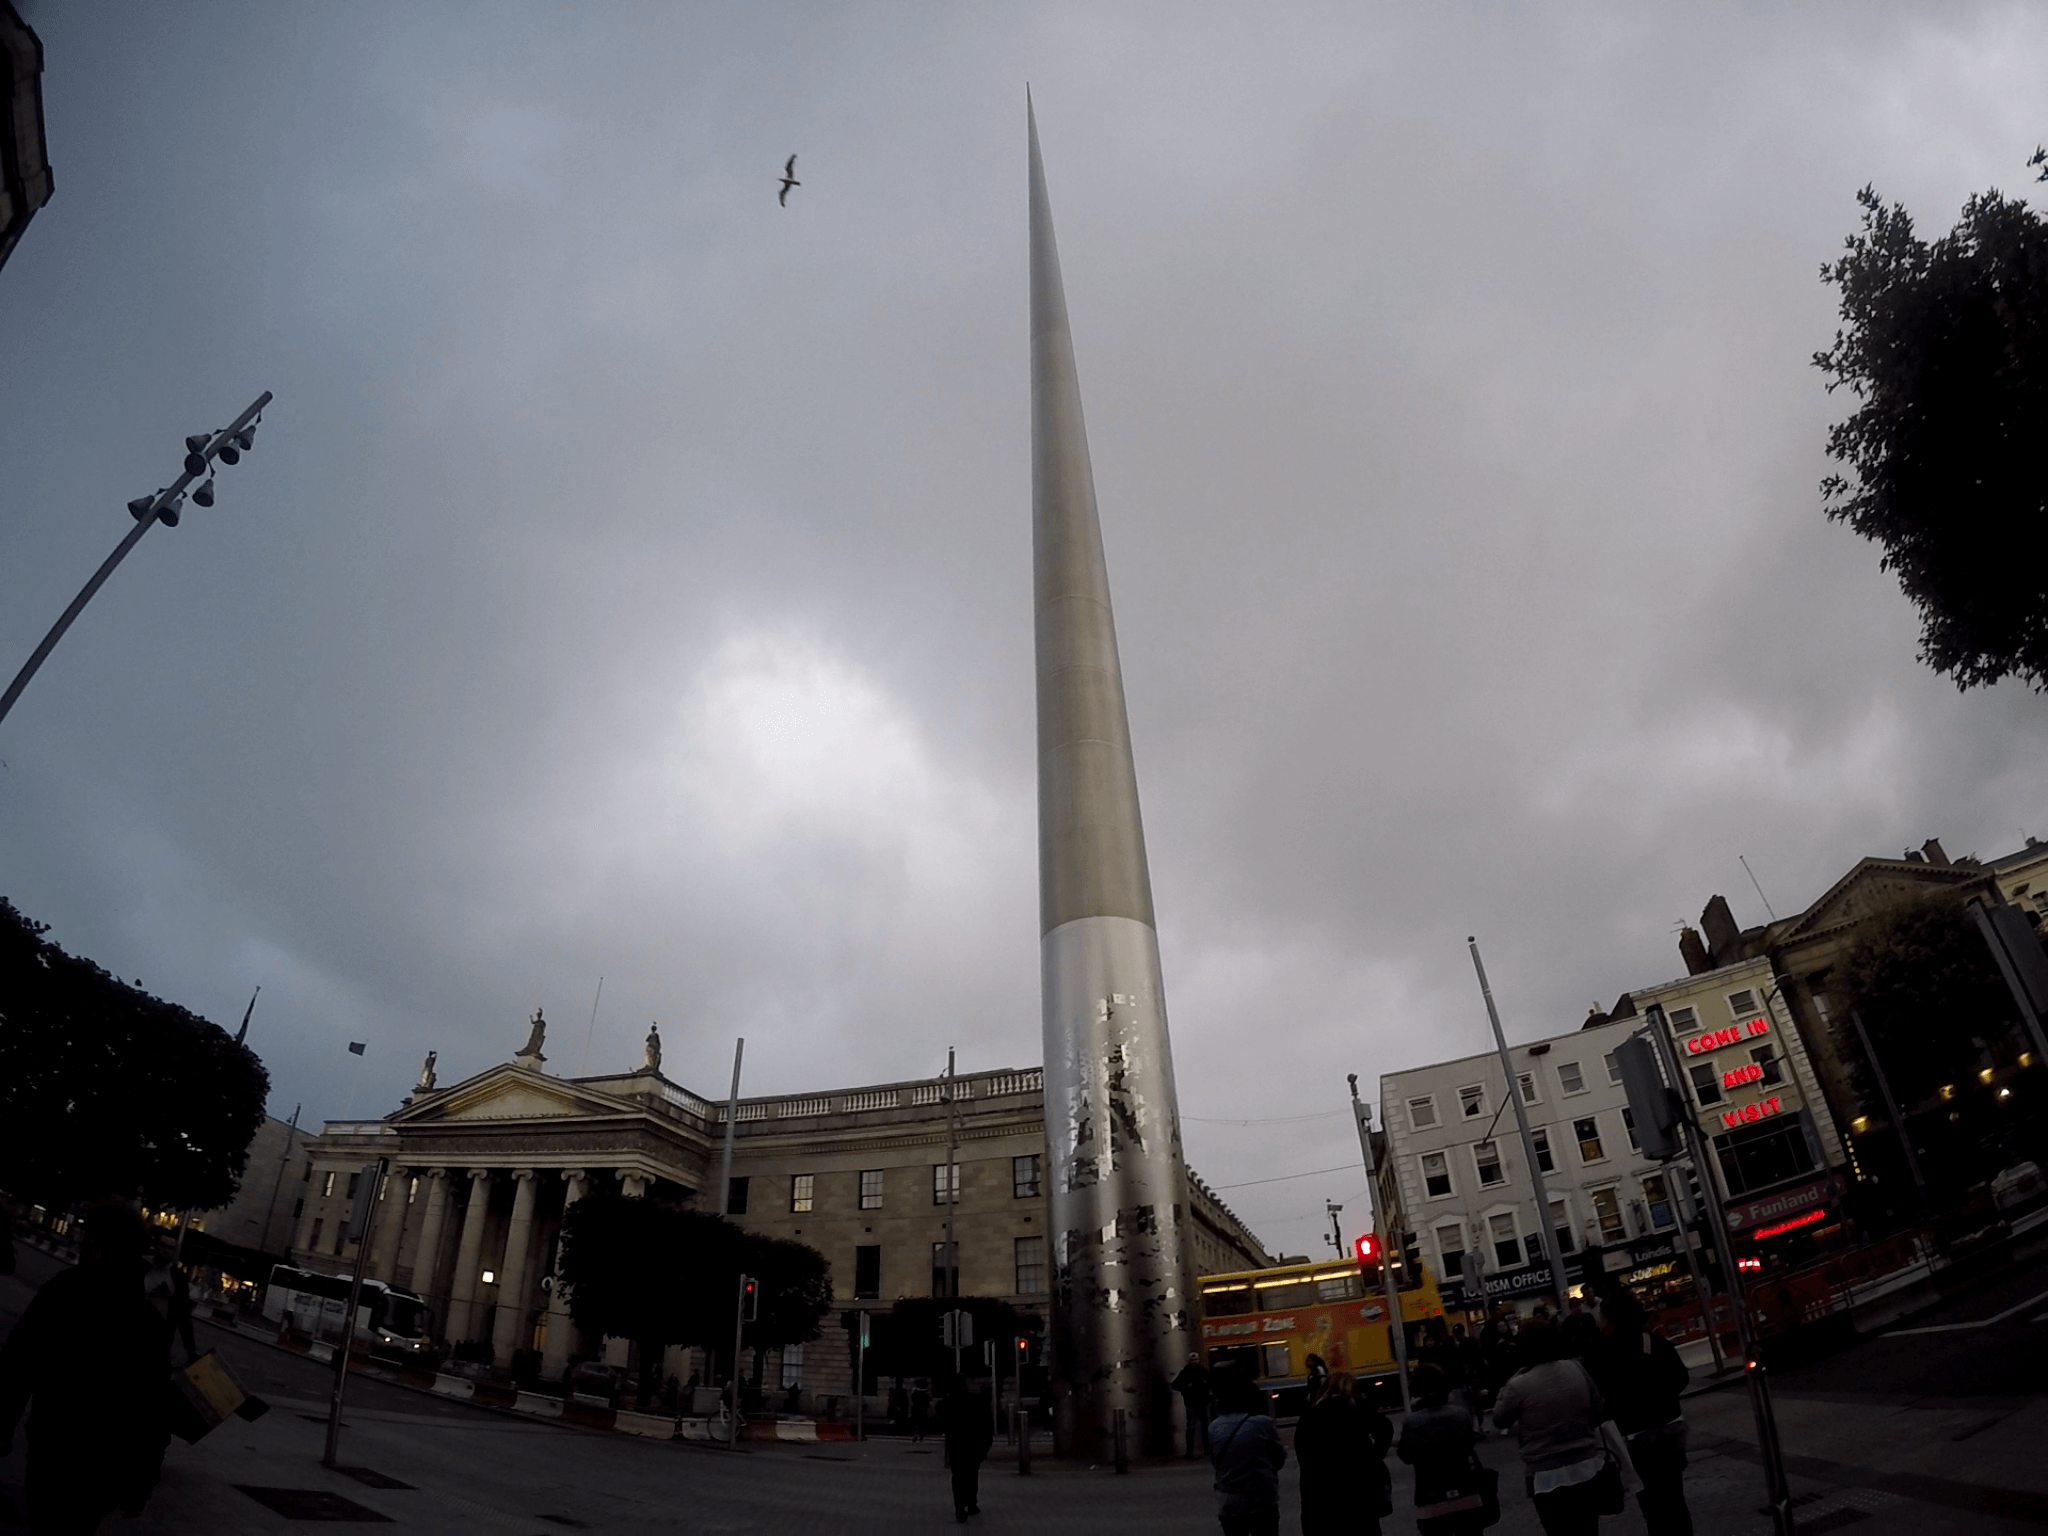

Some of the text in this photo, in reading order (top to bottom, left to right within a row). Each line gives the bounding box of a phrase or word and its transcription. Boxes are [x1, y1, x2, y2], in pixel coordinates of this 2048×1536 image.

[1688, 1017, 1767, 1053] COME IN
[1723, 1063, 1761, 1088] AND
[1722, 1097, 1779, 1127] VISIT
[1748, 1186, 1819, 1220] Funland
[1634, 1245, 1673, 1262] Londis
[1460, 1278, 1511, 1299] TRISM
[1511, 1268, 1552, 1289] OFFICE
[1629, 1260, 1677, 1283] SUBWAY
